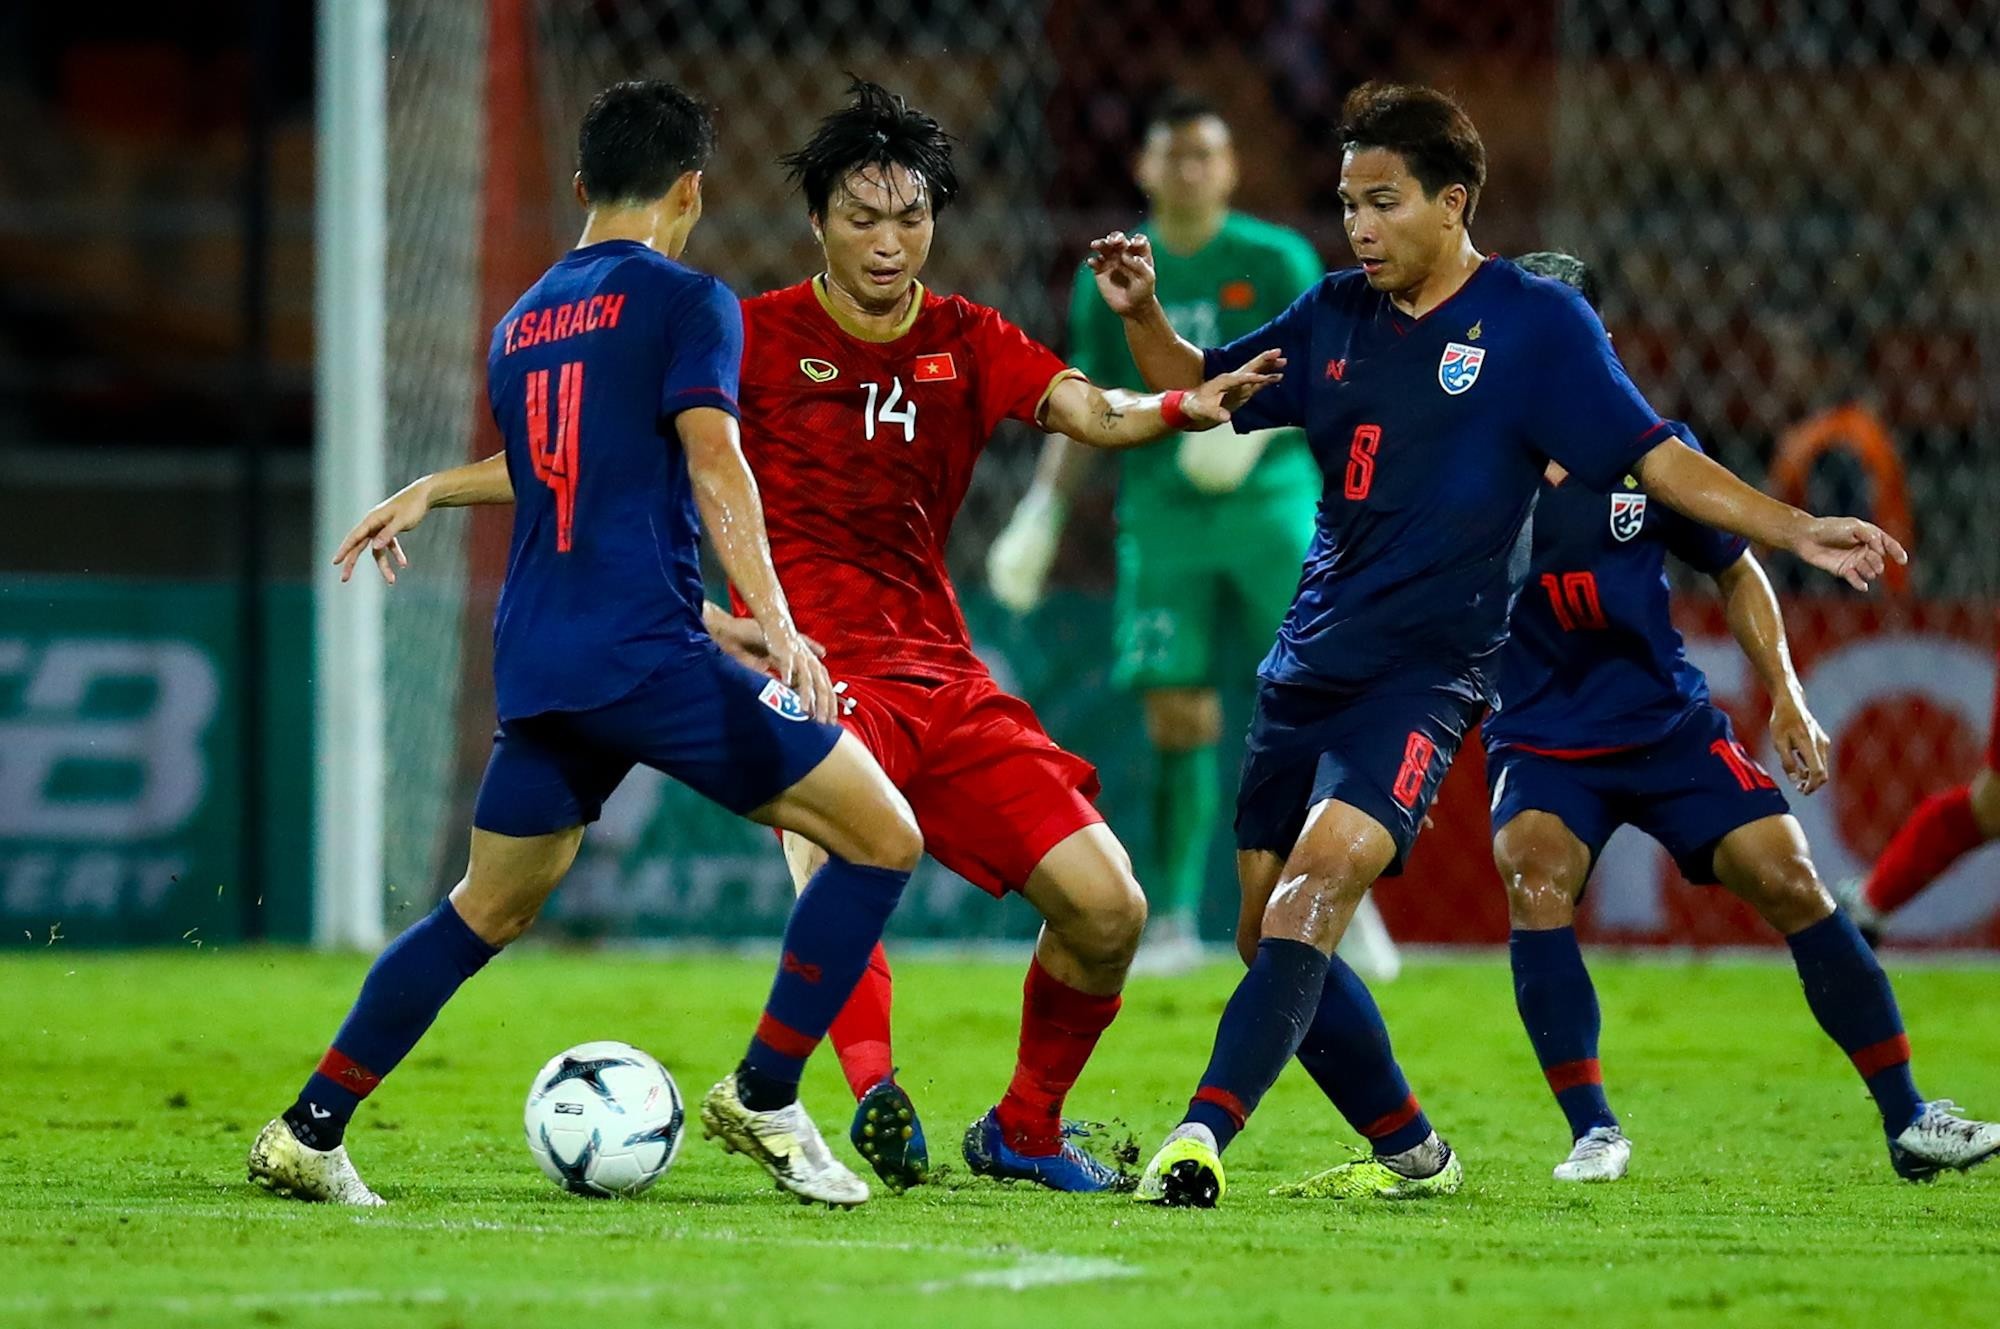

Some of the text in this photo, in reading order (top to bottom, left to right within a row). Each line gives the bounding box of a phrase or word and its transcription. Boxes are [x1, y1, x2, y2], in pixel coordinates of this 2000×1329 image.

[504, 294, 626, 355] Y.SARACH
[860, 376, 917, 442] 14
[526, 361, 583, 552] 4
[1344, 423, 1383, 501] 8
[1541, 571, 1608, 632] 10
[1392, 731, 1434, 809] 8
